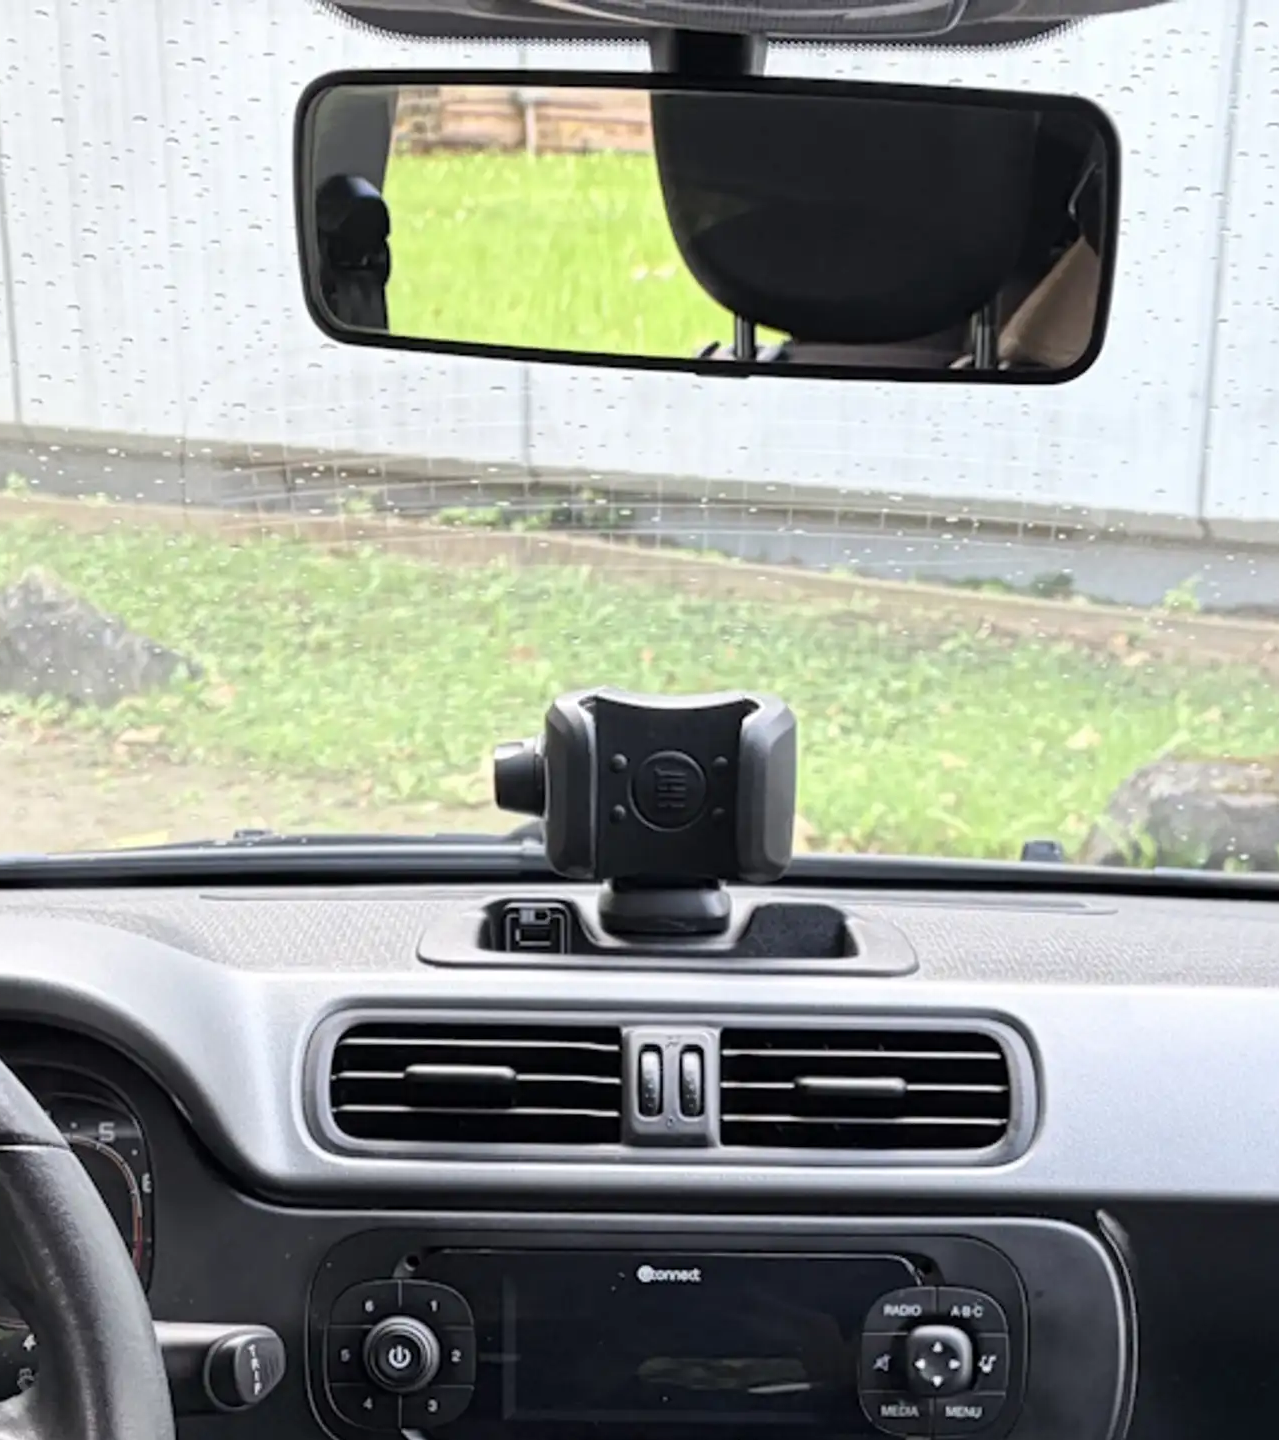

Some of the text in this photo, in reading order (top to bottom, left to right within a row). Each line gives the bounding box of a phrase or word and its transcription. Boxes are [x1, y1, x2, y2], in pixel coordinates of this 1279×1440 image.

[98, 1122, 115, 1141] 5
[364, 1300, 374, 1312] 6
[430, 1300, 438, 1312] 1
[883, 1304, 922, 1317] RADIO
[340, 1349, 350, 1362] 5
[451, 1349, 461, 1362] 2
[248, 1343, 262, 1396] TRIP
[363, 1397, 372, 1410] 4
[427, 1399, 438, 1413] 3
[880, 1404, 919, 1418] MEDIA
[945, 1406, 983, 1419] MENU
